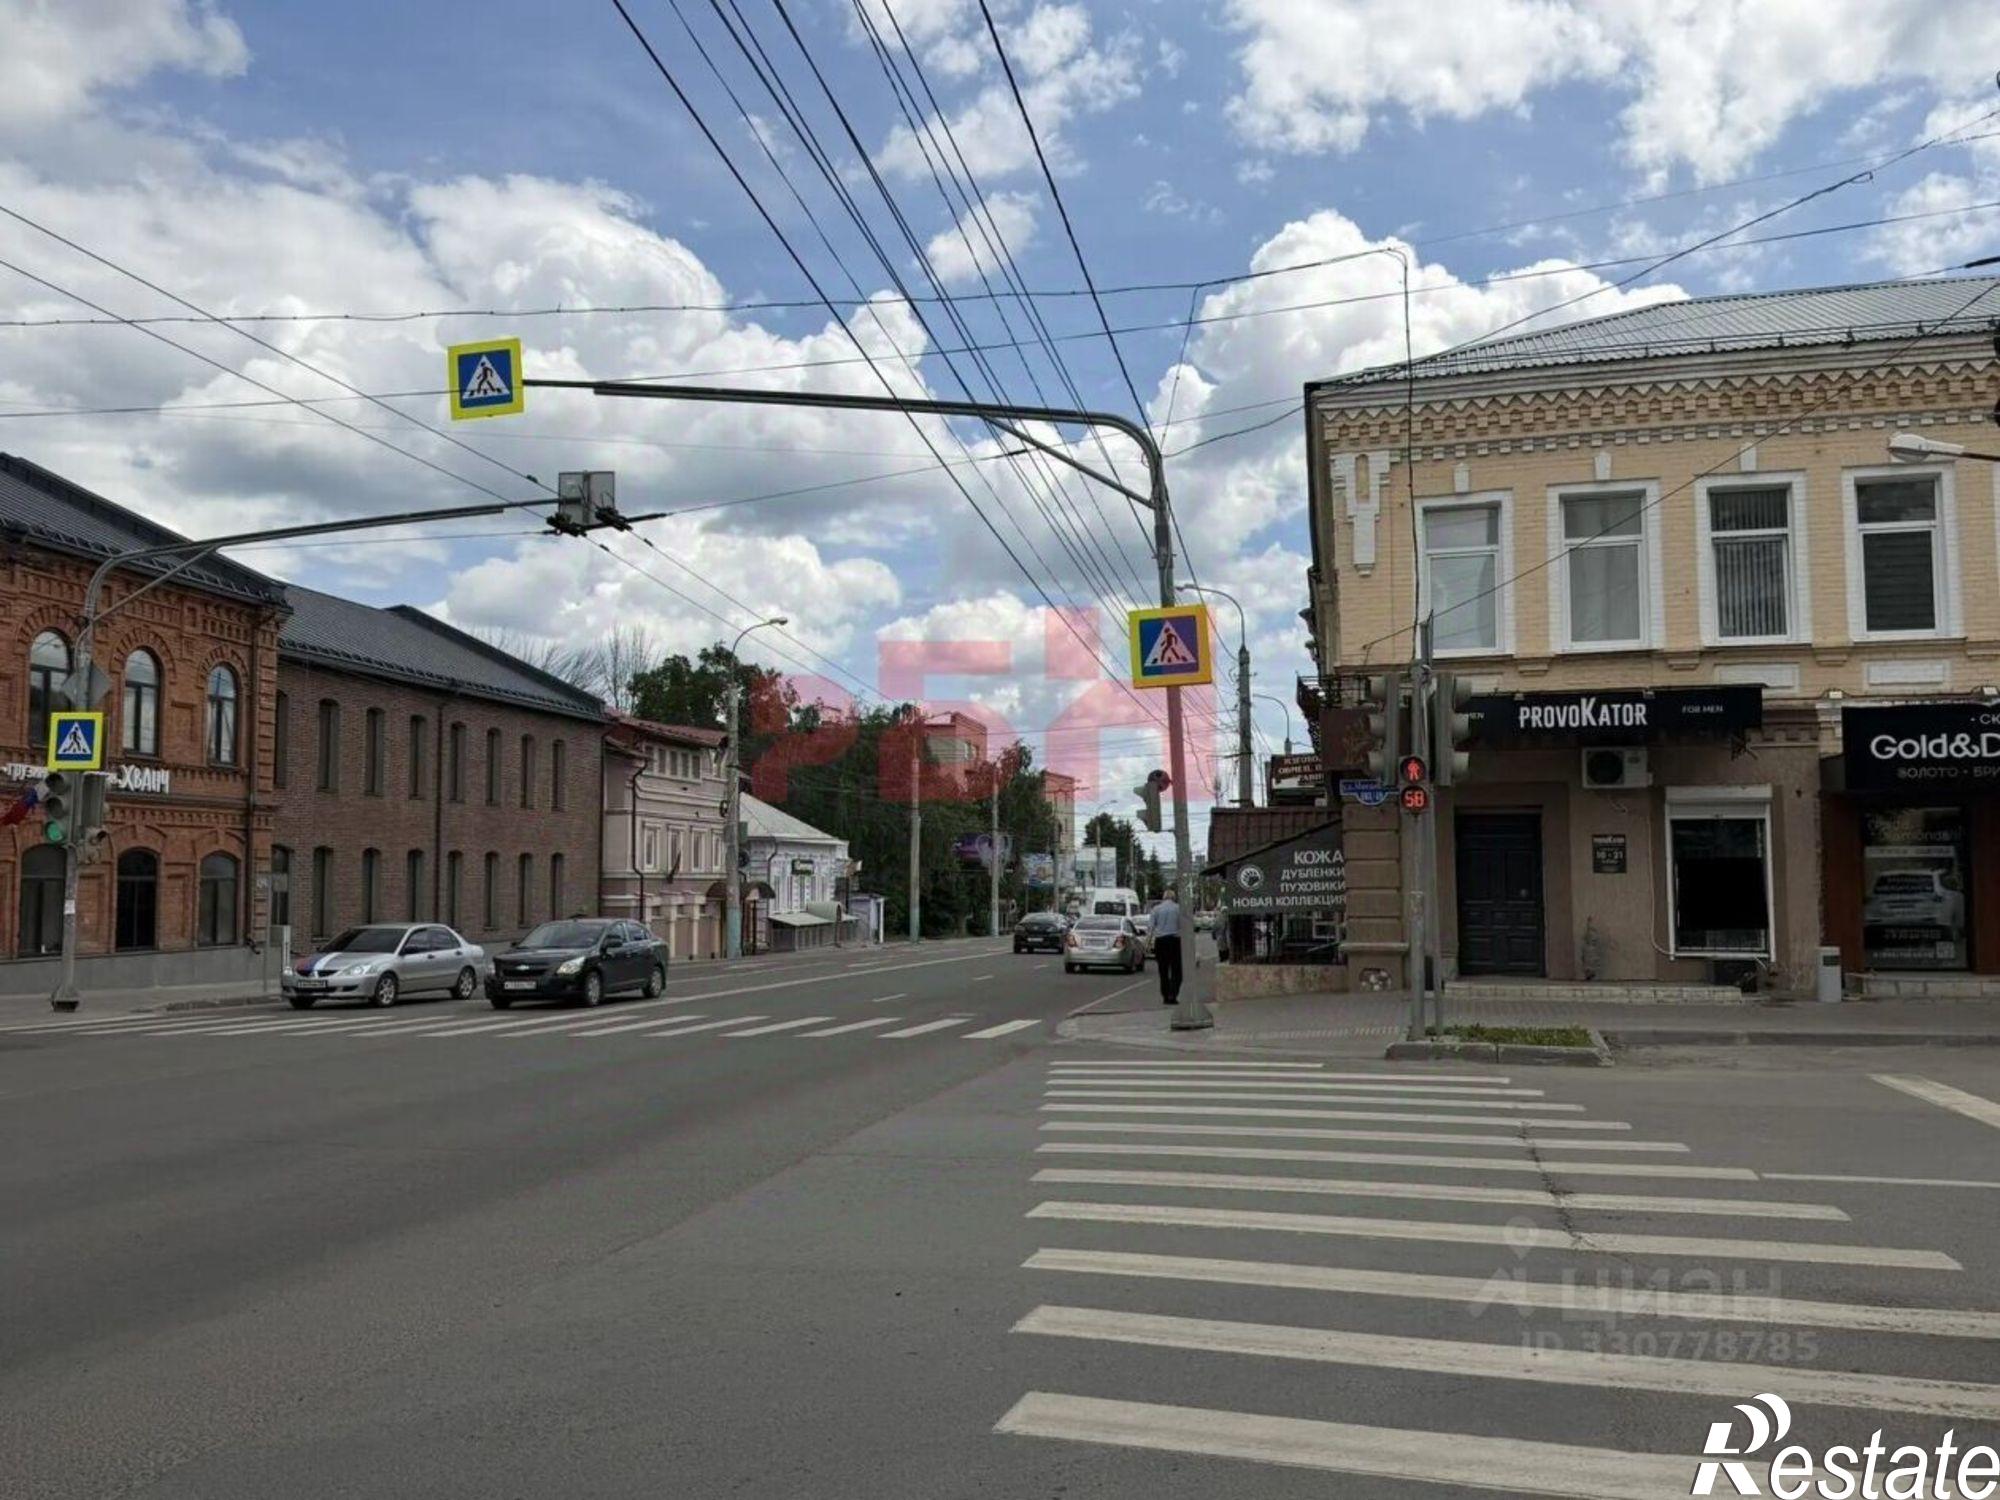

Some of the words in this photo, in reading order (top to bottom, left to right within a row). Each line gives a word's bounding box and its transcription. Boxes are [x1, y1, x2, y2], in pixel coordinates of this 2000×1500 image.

[1703, 704, 1723, 714] MEN
[1293, 850, 1344, 865] КОЖА
[1281, 867, 1345, 880] ДУБЛЕНКИ
[1280, 881, 1346, 893] ПУХОВИКИ
[1232, 896, 1273, 908] НОВАЯ
